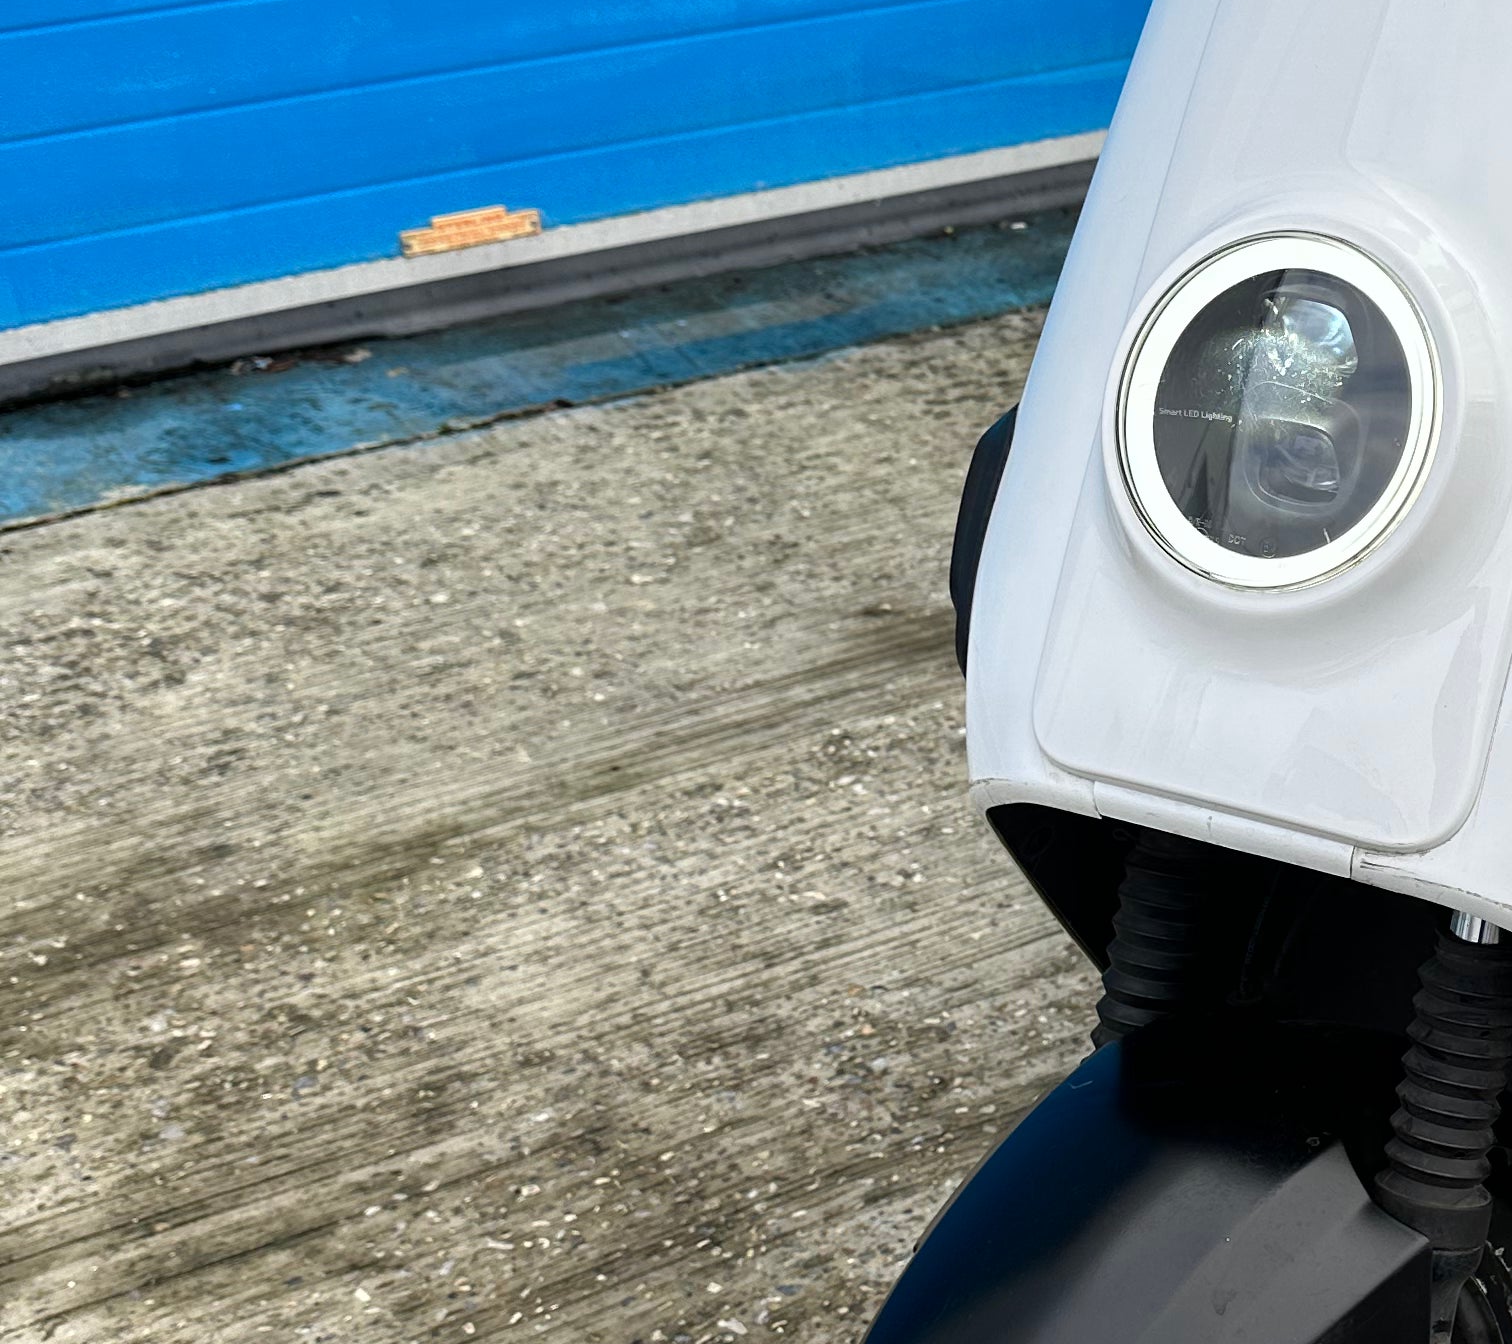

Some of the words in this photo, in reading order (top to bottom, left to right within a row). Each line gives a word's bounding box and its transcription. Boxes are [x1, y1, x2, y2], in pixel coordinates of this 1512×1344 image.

[1159, 407, 1183, 417] Smart
[1184, 409, 1200, 418] LED
[1201, 410, 1233, 423] Lighting
